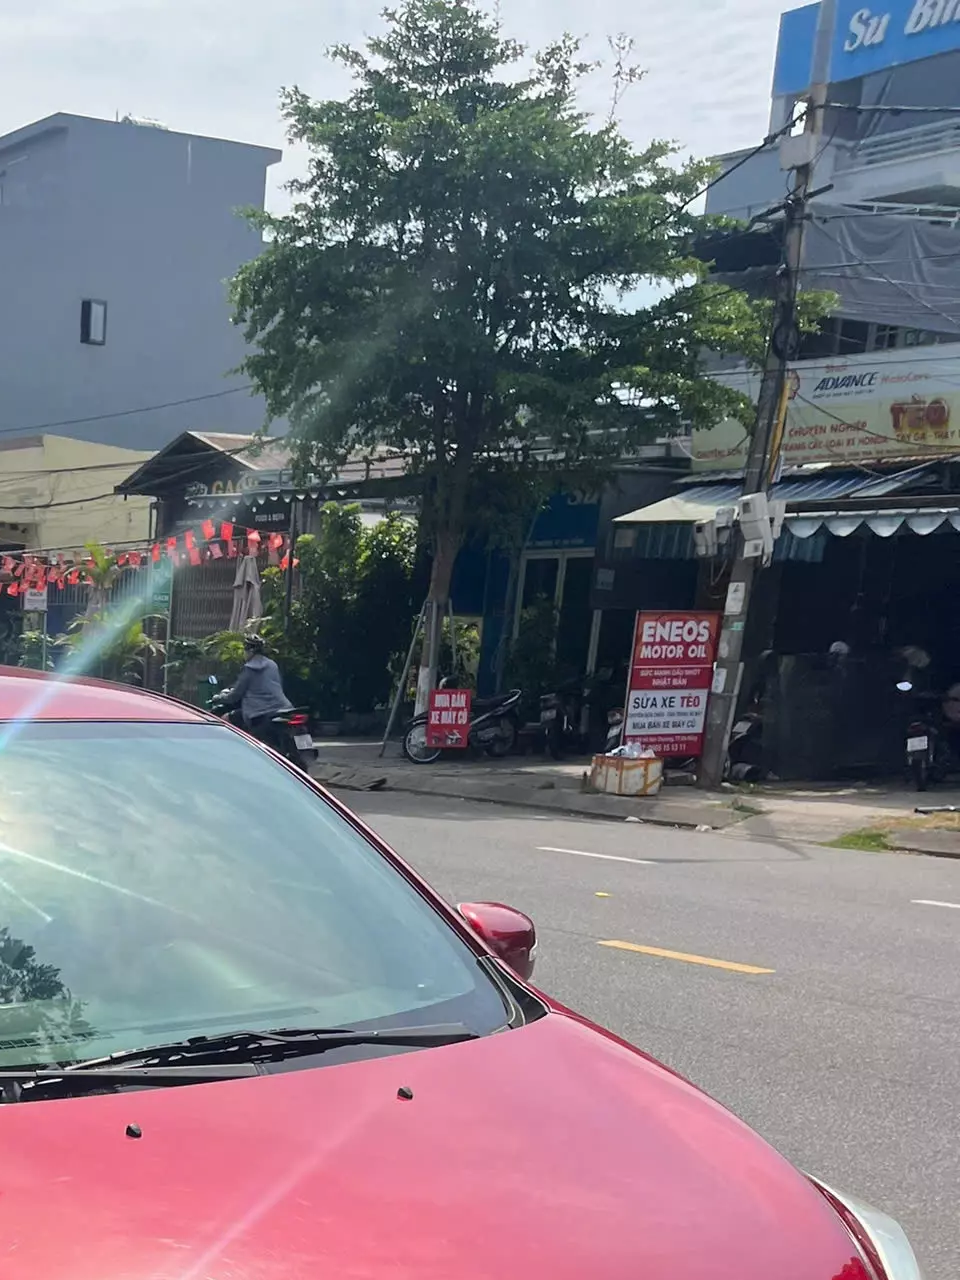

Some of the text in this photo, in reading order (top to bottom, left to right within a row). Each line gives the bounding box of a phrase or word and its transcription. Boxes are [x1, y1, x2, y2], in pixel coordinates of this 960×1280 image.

[844, 7, 891, 52] Su
[813, 371, 879, 392] ADVANCE
[642, 620, 710, 643] ENEOS
[640, 645, 707, 659] MOTOR OIL
[633, 693, 658, 710] SỬA
[661, 696, 676, 709] XE
